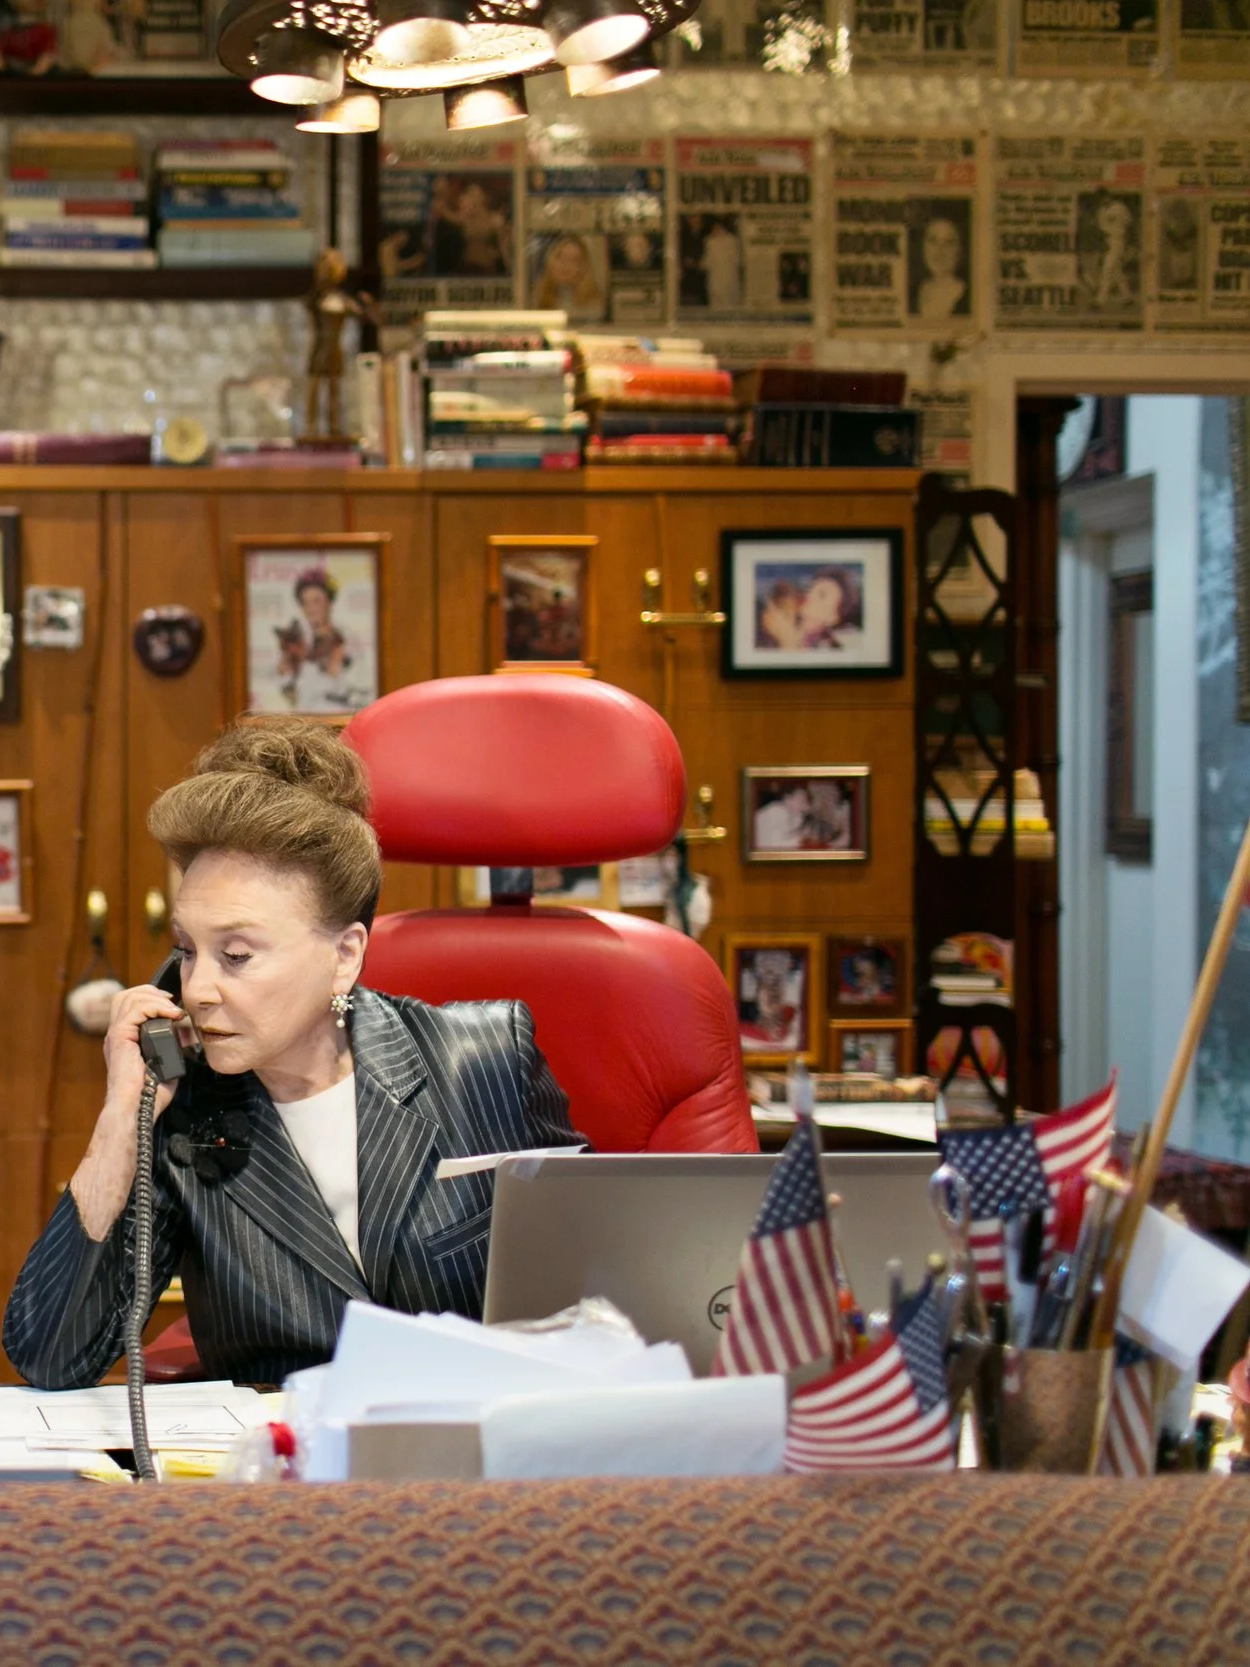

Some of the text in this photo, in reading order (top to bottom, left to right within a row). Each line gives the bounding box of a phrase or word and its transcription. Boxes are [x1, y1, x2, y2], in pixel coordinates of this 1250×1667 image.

[1025, 1, 1120, 28] BROOKS
[679, 175, 811, 205] UNVEILED
[998, 284, 1078, 307] SEATTLE
